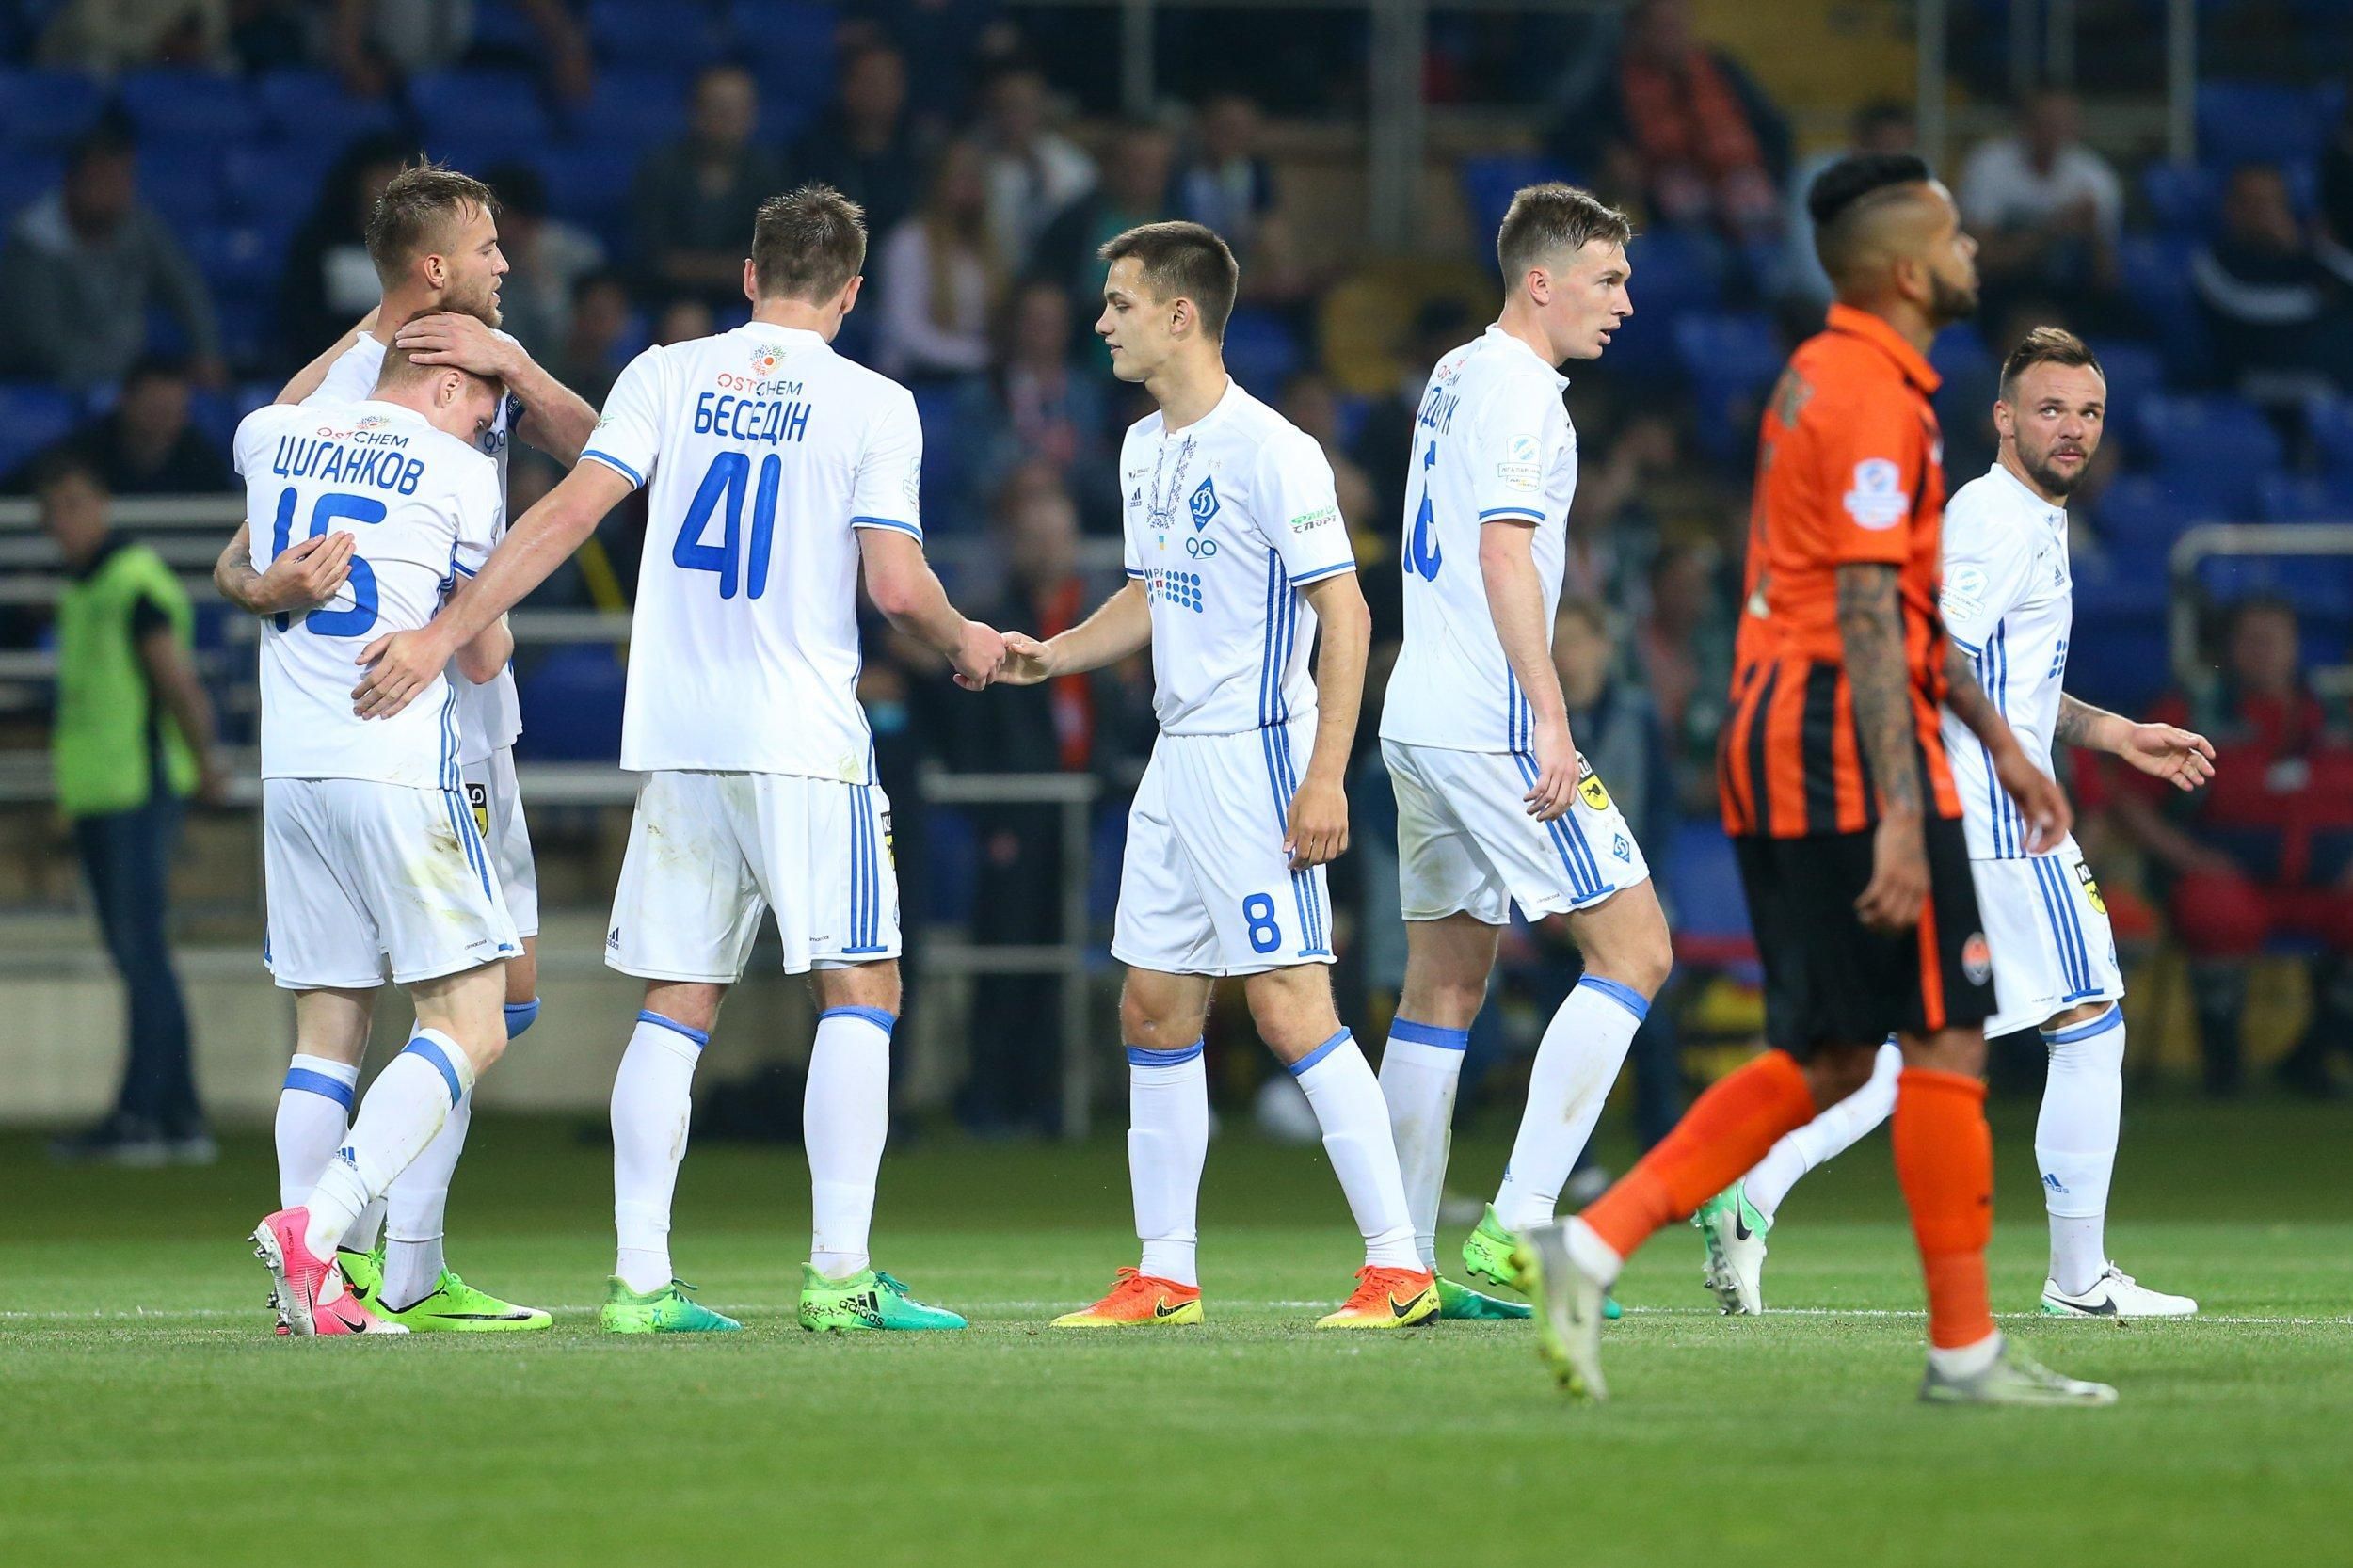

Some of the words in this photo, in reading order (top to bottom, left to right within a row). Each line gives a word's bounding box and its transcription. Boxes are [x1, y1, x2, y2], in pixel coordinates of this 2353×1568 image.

[716, 373, 803, 396] OSTCHEM
[316, 426, 409, 449] OSTCHEM
[694, 392, 811, 447] БЕСЕДІН
[272, 434, 425, 496] ЦИГАНКОВ
[673, 452, 782, 600] 41
[1186, 536, 1218, 560] 90
[271, 486, 388, 638] 15
[1242, 892, 1282, 954] 8
[839, 1299, 885, 1327] adidas
